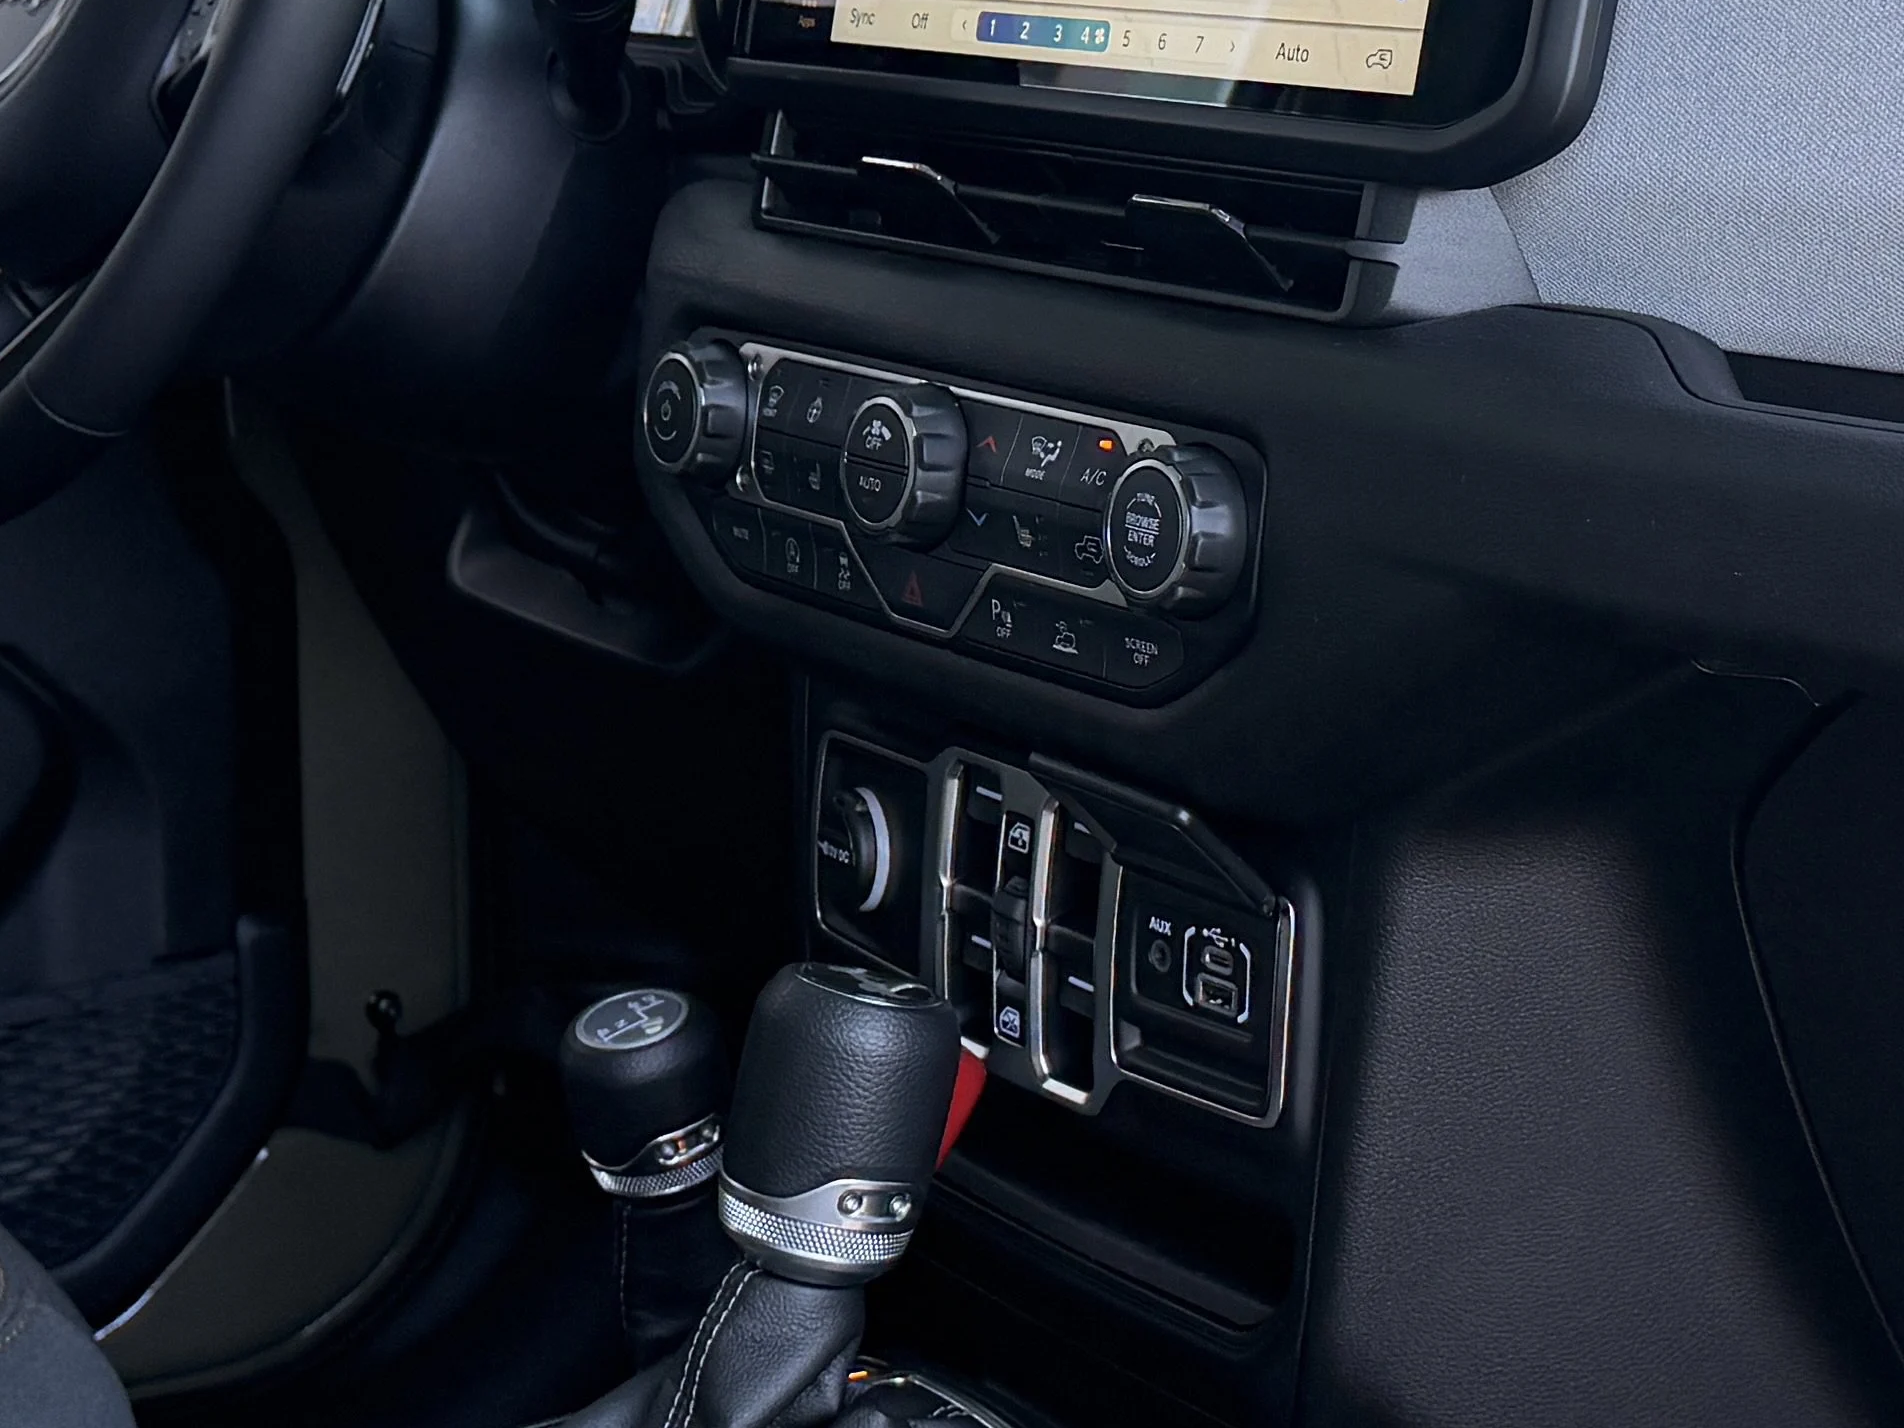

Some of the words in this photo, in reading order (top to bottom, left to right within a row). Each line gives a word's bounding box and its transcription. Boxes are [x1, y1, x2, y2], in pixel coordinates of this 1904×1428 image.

[849, 7, 875, 27] Sync
[911, 12, 929, 29] Off
[1020, 22, 1029, 39] 2
[1053, 24, 1062, 42] 3
[1080, 27, 1090, 44] 4
[1122, 29, 1131, 47] 5
[1157, 33, 1167, 50] 6
[1194, 35, 1204, 54] 7
[1275, 42, 1310, 63] Auto
[858, 475, 882, 492] AUTO
[1080, 467, 1107, 486] A/C
[1125, 511, 1160, 531] BROWSE
[1127, 529, 1156, 548] ENTER
[1124, 636, 1159, 656] SCREEN
[1132, 652, 1150, 667] OFF
[1149, 916, 1172, 936] AUX
